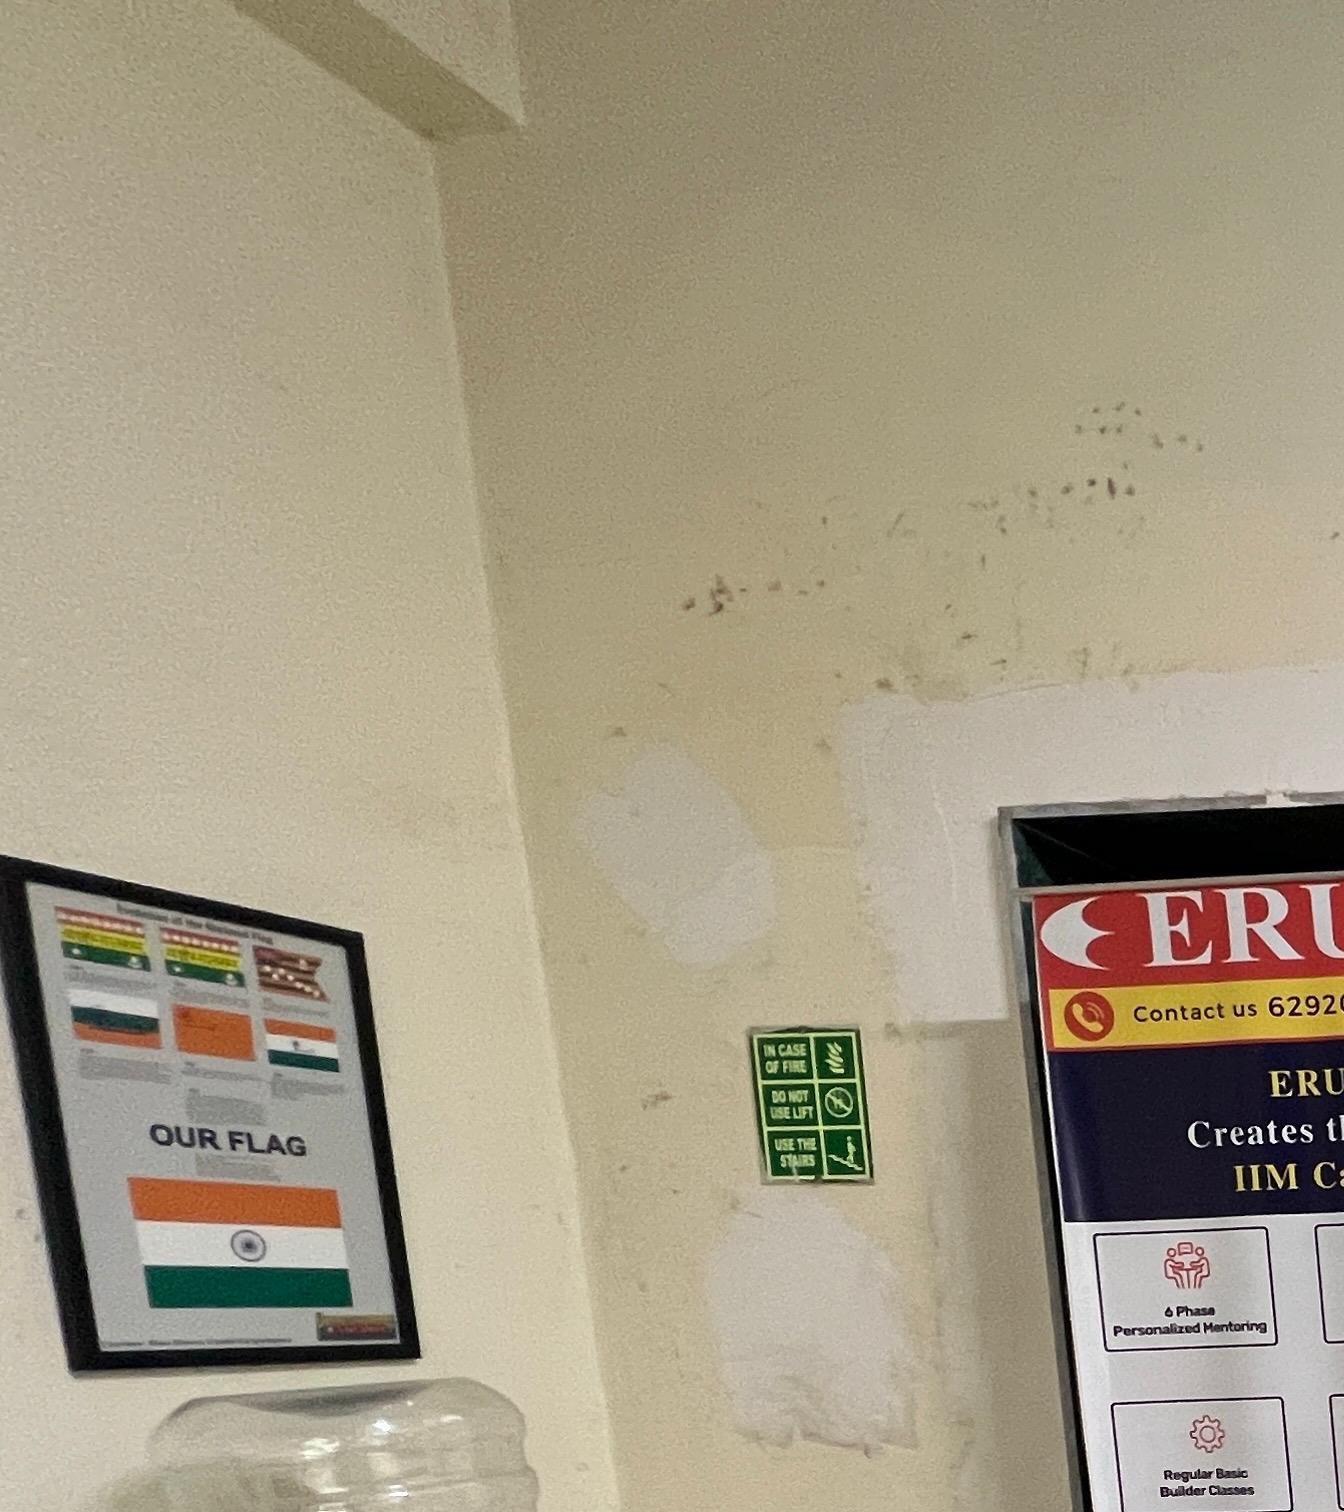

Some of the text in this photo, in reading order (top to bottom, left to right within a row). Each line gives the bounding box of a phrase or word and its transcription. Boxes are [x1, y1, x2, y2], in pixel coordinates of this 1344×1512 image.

[1133, 1003, 1225, 1023] Contact
[1233, 1002, 1258, 1018] us
[763, 1043, 807, 1057] IN CASE
[765, 1060, 807, 1074] OF FIRE
[771, 1090, 809, 1104] DO NOT
[770, 1106, 814, 1120] USE LIFT
[1186, 1116, 1314, 1148] Creates
[149, 1124, 307, 1157] OUR FLAG
[774, 1137, 817, 1151] USE THE
[780, 1153, 815, 1168] STAIRS
[1233, 1162, 1298, 1193] IIM
[1164, 1305, 1216, 1318] 6 Phase
[1113, 1320, 1268, 1337] Personalized Mentoring
[1163, 1468, 1249, 1483] Regular Basic
[1160, 1485, 1256, 1497] Builder Classes
